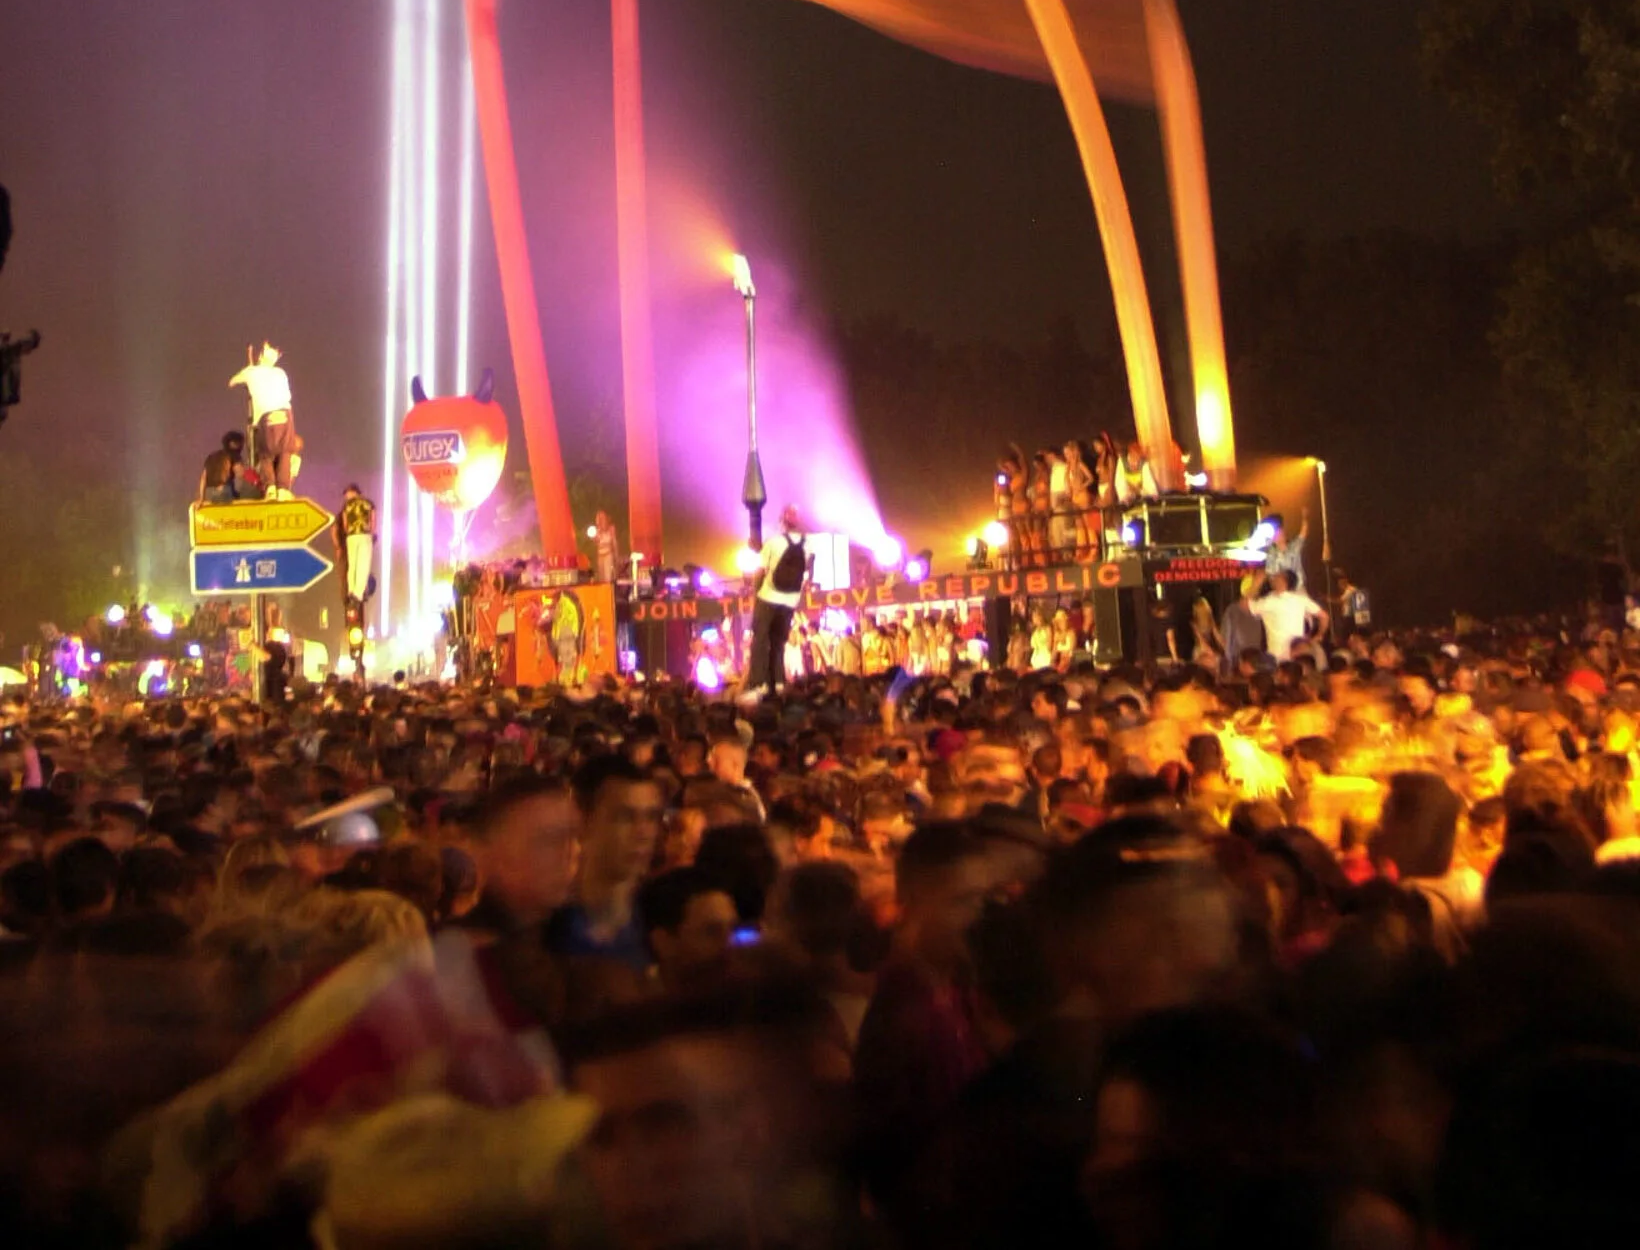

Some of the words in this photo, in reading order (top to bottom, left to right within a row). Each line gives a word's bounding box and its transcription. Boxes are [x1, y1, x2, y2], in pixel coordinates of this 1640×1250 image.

[403, 436, 455, 461] durex
[634, 600, 698, 621] JOIN
[718, 597, 755, 616] TH
[805, 581, 894, 610] LOVE
[919, 563, 1121, 600] REPUBLIC
